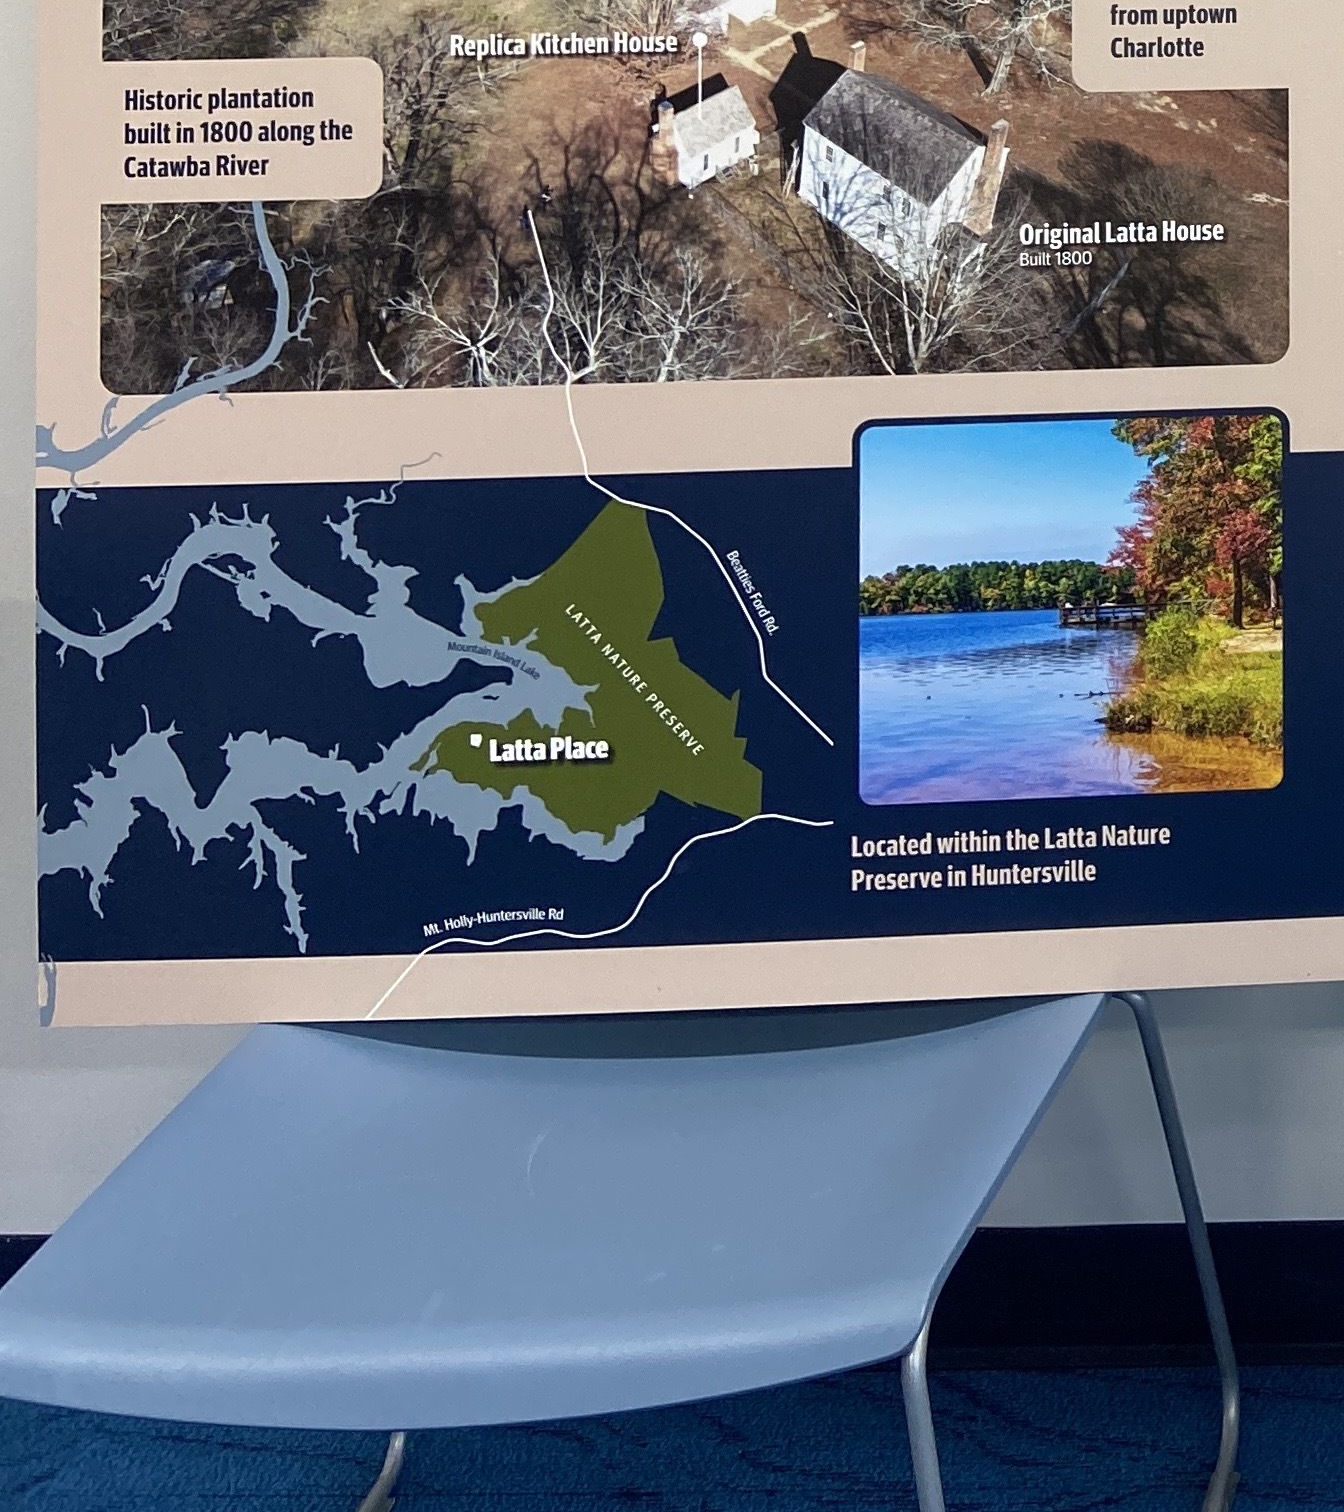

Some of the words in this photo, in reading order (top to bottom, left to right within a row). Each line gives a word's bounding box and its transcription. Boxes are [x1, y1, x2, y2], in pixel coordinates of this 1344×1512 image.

[1109, 2, 1158, 26] from
[1161, 3, 1237, 30] uptown
[449, 32, 526, 61] Replica
[529, 30, 609, 55] Kitchen
[613, 28, 678, 53] House
[1109, 35, 1205, 59] Charlotte
[123, 86, 203, 111] Historic
[206, 85, 314, 115] plantation
[123, 120, 171, 145] built
[175, 120, 195, 144] in
[198, 119, 253, 143] 1800
[256, 118, 315, 147] along
[318, 117, 353, 141] the
[123, 154, 211, 178] Catawba
[215, 152, 270, 177] River
[1018, 220, 1101, 250] Original
[1104, 220, 1157, 243] Latta
[1161, 219, 1224, 242] House
[1018, 251, 1051, 267] Built
[1054, 249, 1092, 266] 1800
[726, 550, 756, 594] Beatties
[749, 592, 771, 618] Ford
[762, 616, 780, 637] Rd.
[447, 641, 492, 657] Mountain
[493, 645, 521, 668] Island
[519, 660, 541, 680] Lake
[565, 603, 602, 645] LATTA
[601, 643, 647, 693] NATURE
[645, 692, 705, 756] PRESERVE
[488, 737, 547, 762] Latta
[549, 734, 609, 760] Place
[850, 831, 932, 858] Located
[935, 828, 1001, 854] within
[1004, 827, 1040, 851] the
[1043, 826, 1097, 849] Latta
[1101, 823, 1171, 847] Nature
[850, 868, 943, 891] Preserve
[946, 863, 967, 887] in
[970, 858, 1096, 886] Huntersville
[423, 923, 444, 937] Mt.
[444, 908, 546, 931] Holly-Huntersville
[548, 908, 564, 920] Rd
